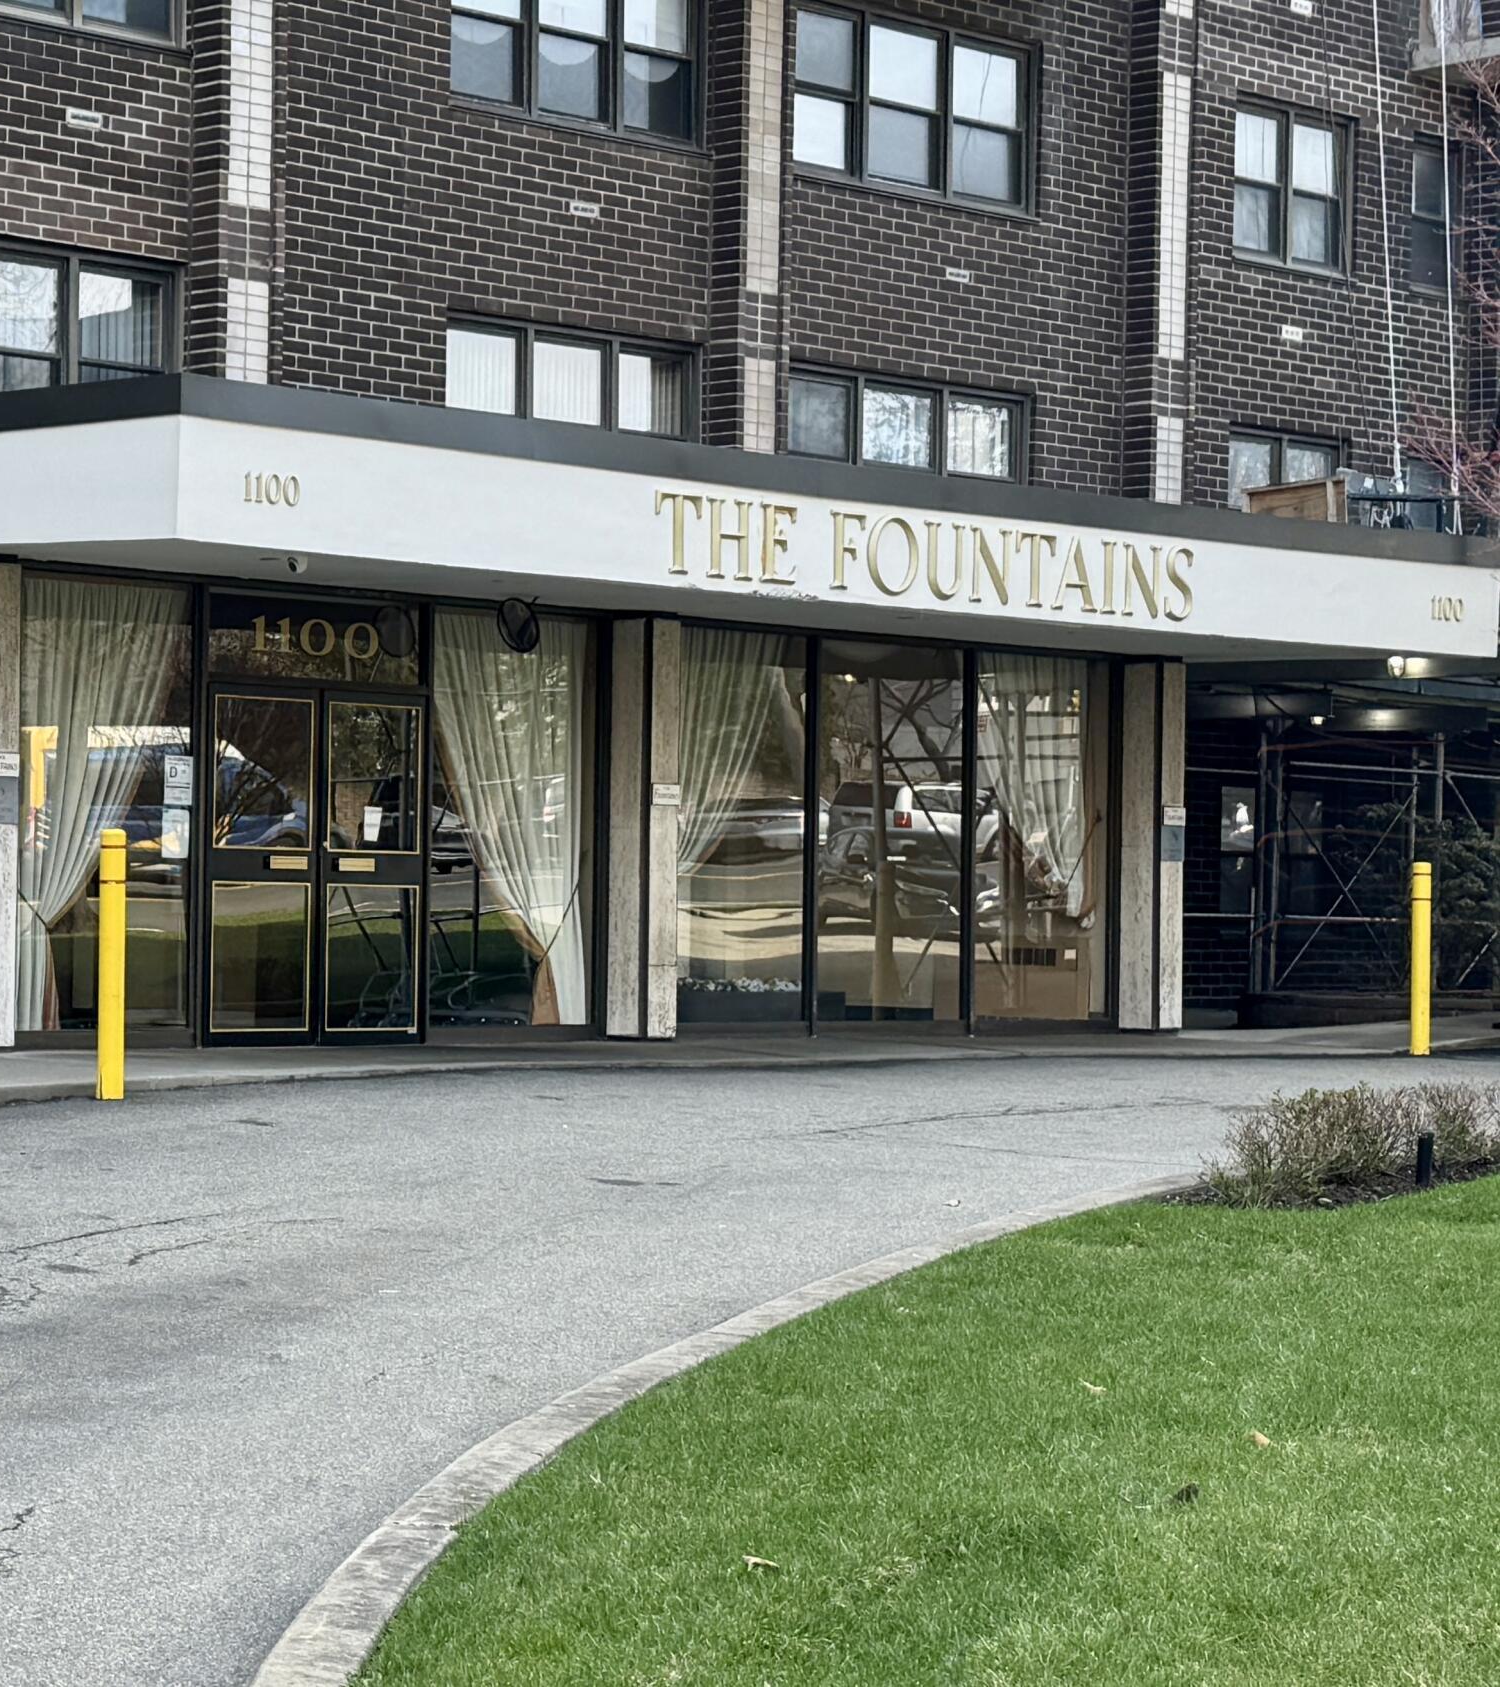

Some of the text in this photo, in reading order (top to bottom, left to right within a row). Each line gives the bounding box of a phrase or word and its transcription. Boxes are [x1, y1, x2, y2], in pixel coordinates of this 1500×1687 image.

[243, 470, 300, 507] 1100
[655, 489, 1194, 622] THE FOUNTAINS
[1430, 594, 1464, 623] 1100
[251, 615, 379, 659] 1100
